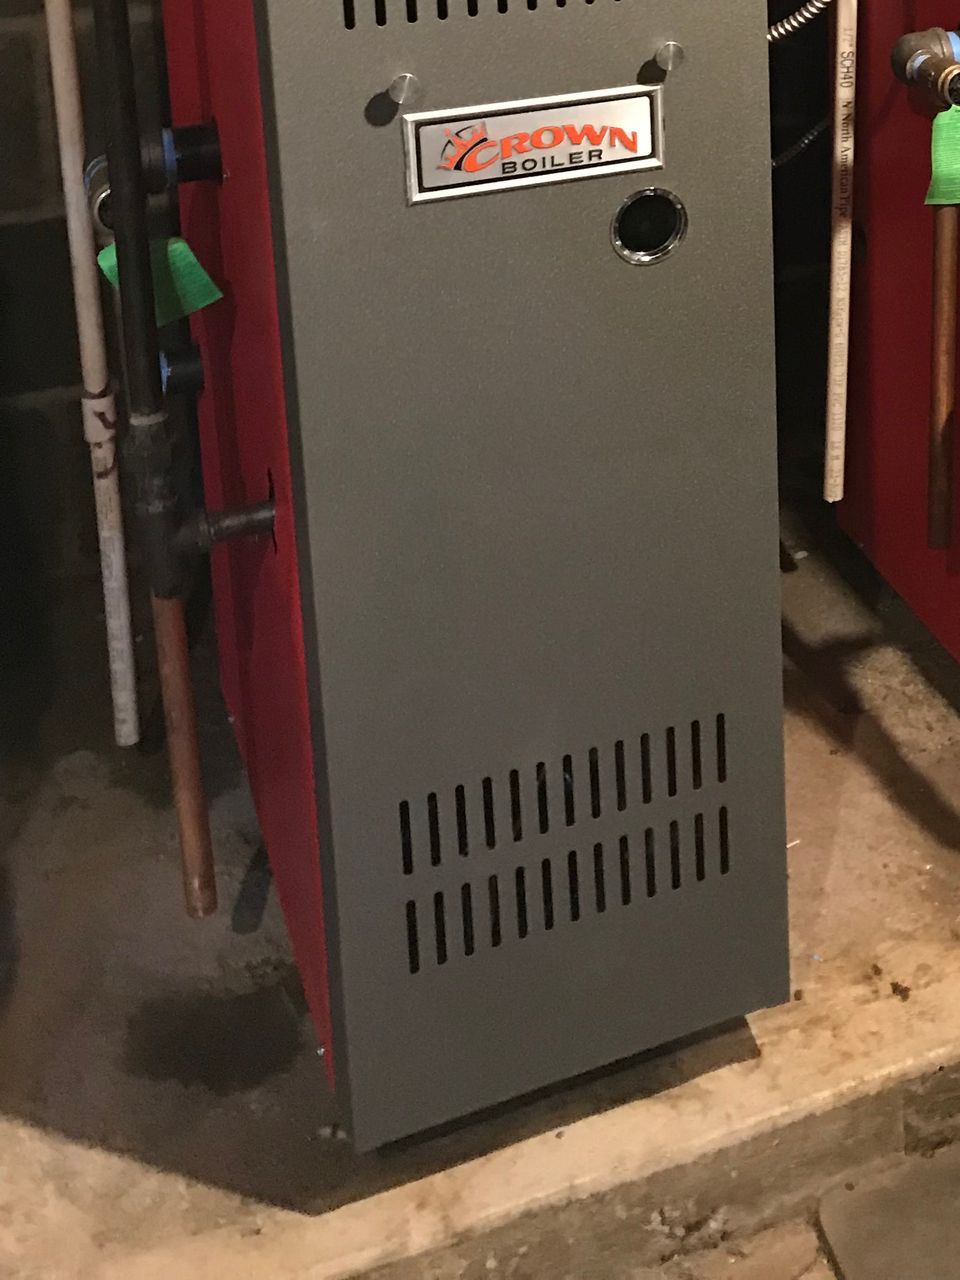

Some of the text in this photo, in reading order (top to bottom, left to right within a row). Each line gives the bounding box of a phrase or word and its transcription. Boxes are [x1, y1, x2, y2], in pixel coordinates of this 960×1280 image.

[839, 51, 854, 88] SCH40
[840, 113, 852, 142] North
[463, 123, 638, 173] CROWN
[501, 149, 603, 174] BOILER
[839, 147, 852, 193] American
